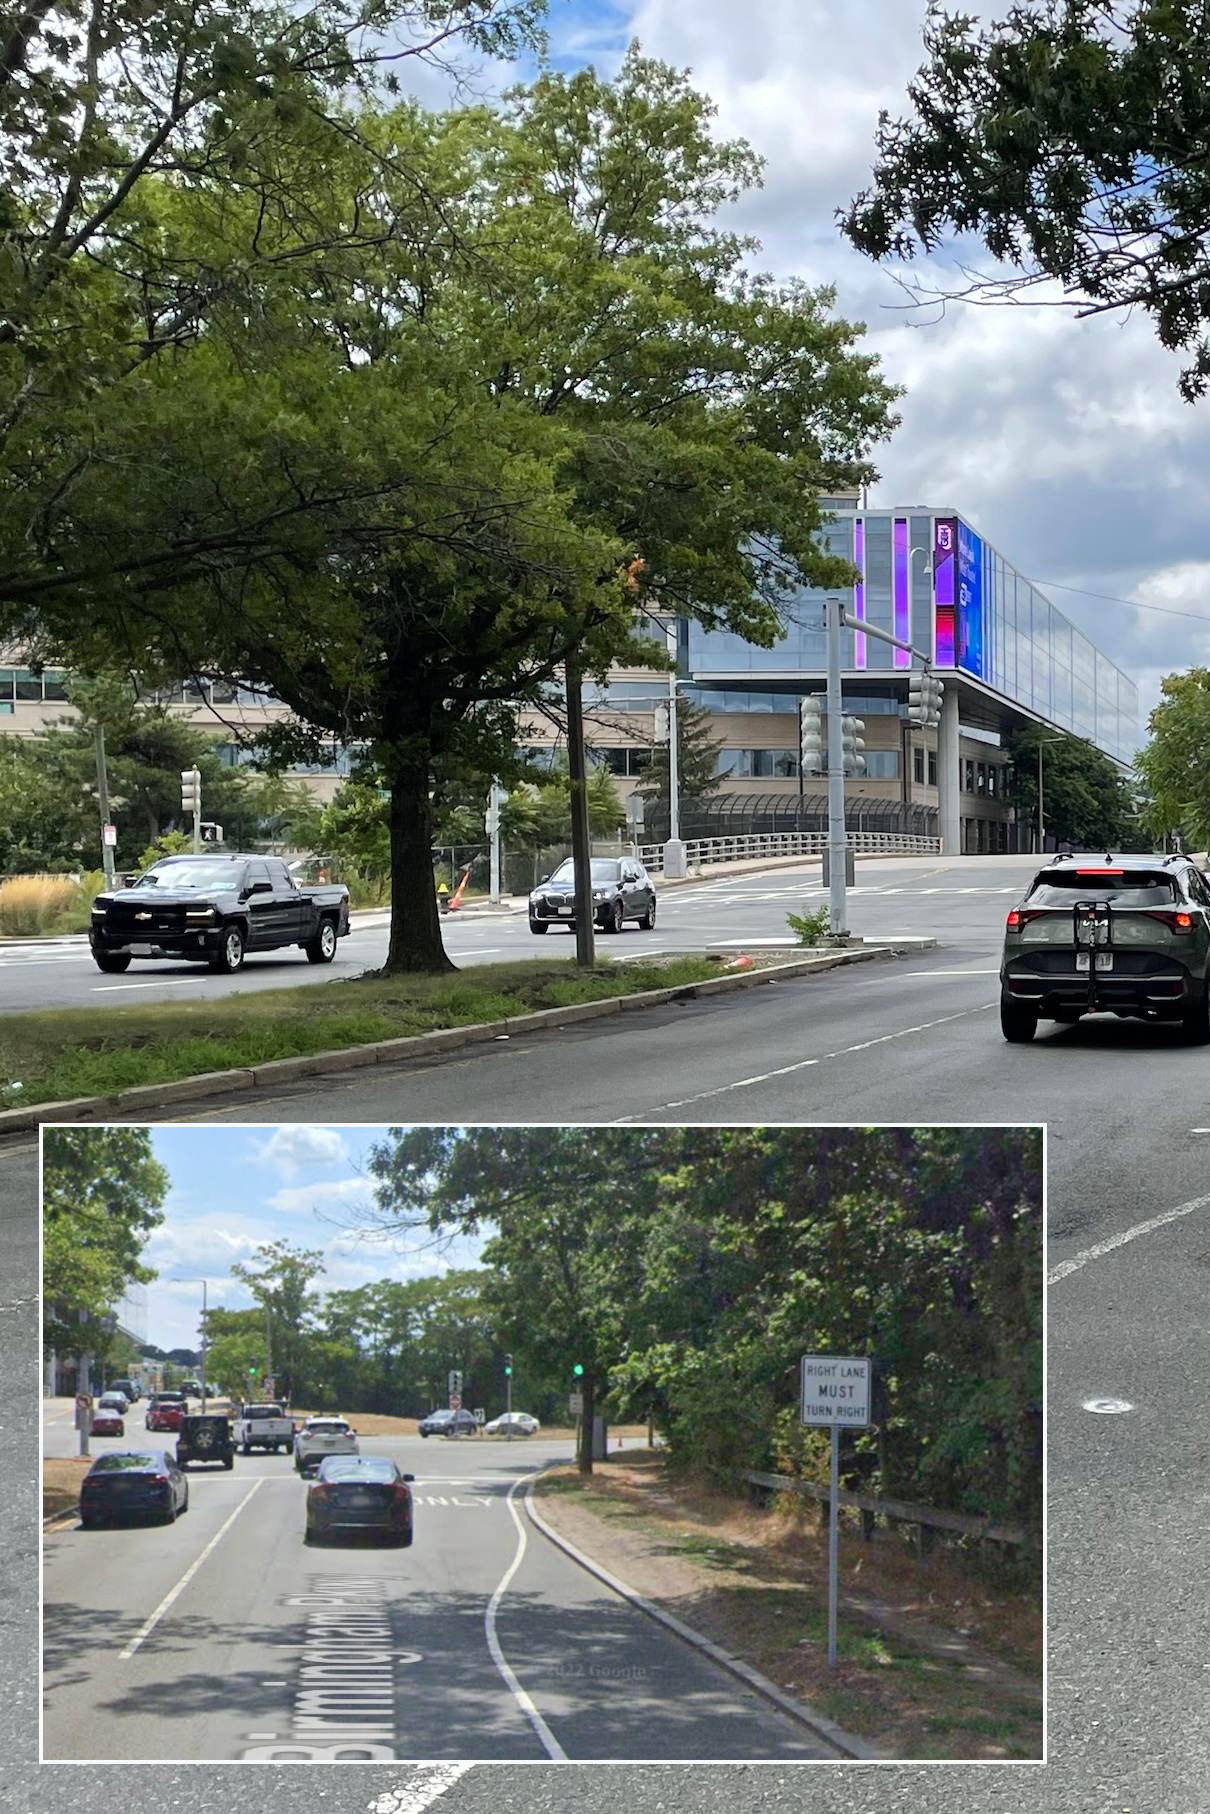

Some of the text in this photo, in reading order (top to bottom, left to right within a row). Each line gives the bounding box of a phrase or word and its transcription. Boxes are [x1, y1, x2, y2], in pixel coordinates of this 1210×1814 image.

[807, 1364, 867, 1379] RIGHT LANE
[818, 1384, 854, 1399] MUST
[806, 1404, 866, 1418] TURN RIGHT
